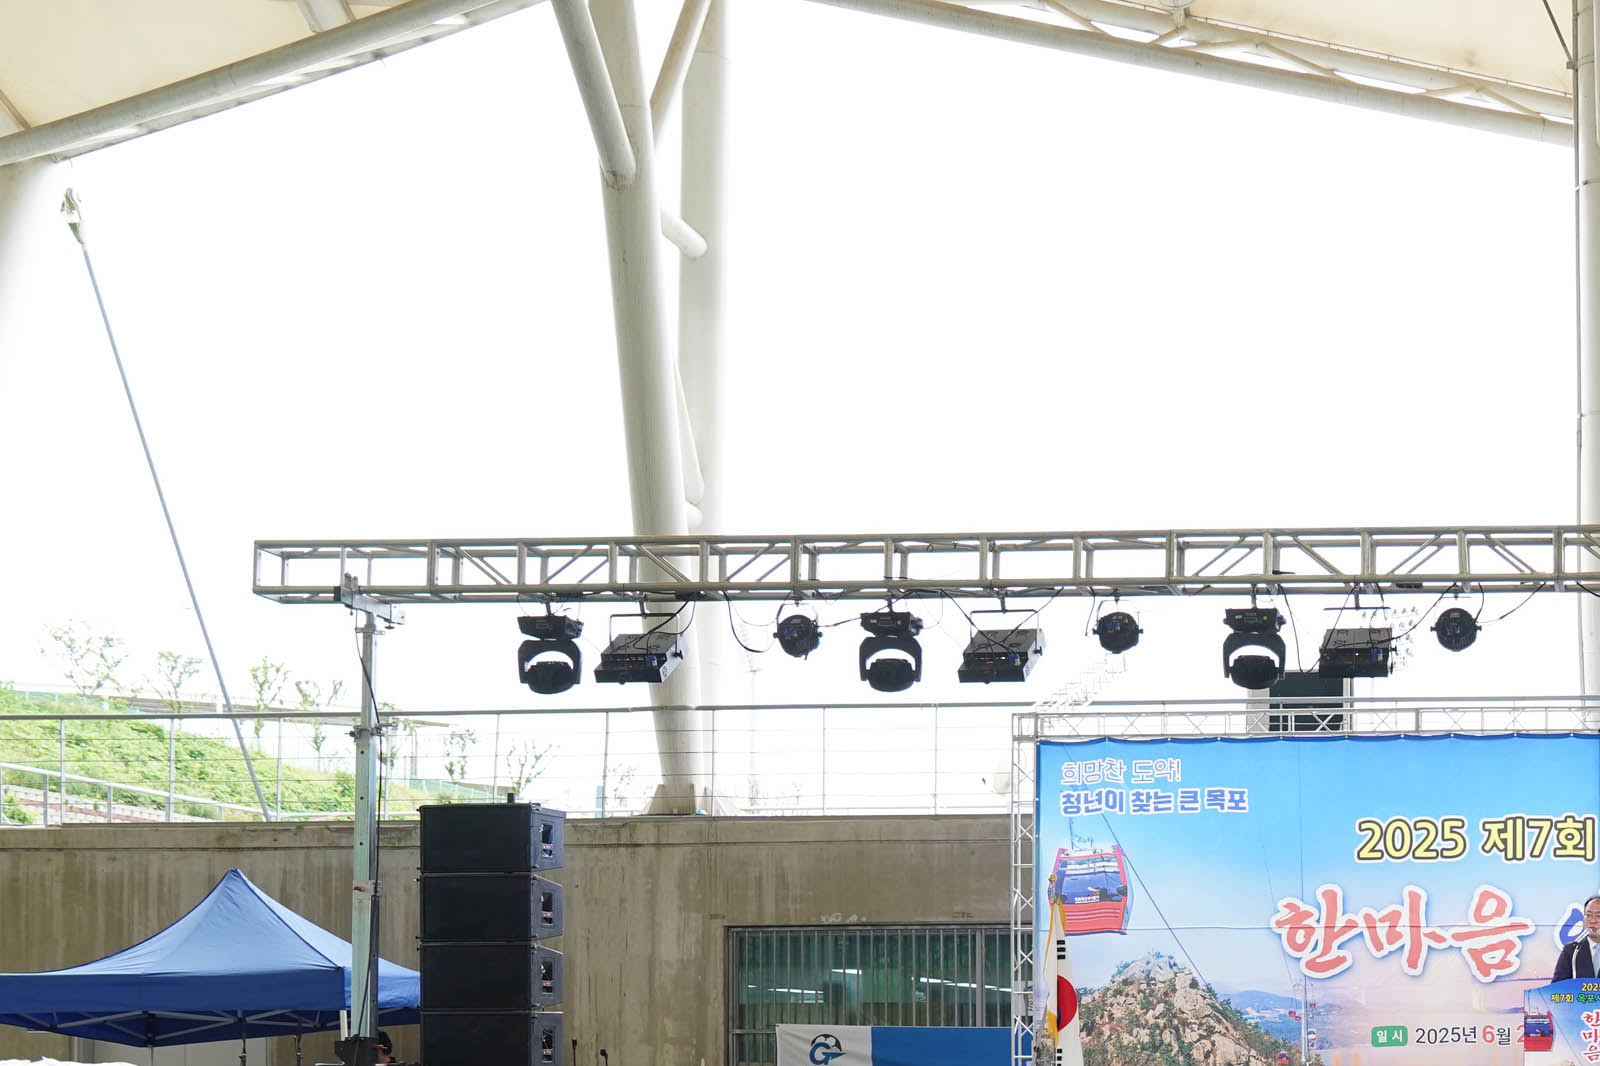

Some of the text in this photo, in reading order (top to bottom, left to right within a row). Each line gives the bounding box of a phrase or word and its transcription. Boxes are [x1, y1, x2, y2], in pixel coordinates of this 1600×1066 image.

[1061, 757, 1182, 785] 희망찬 도약!
[1061, 787, 1249, 817] 청년이 찾는 큰 목포
[1356, 816, 1468, 862] 2025
[1481, 814, 1598, 862] 제7회
[1272, 885, 1534, 981] 한마음
[1551, 993, 1574, 1003] 제7회
[1415, 1026, 1478, 1045] 2025년
[1482, 1024, 1512, 1046] 6월
